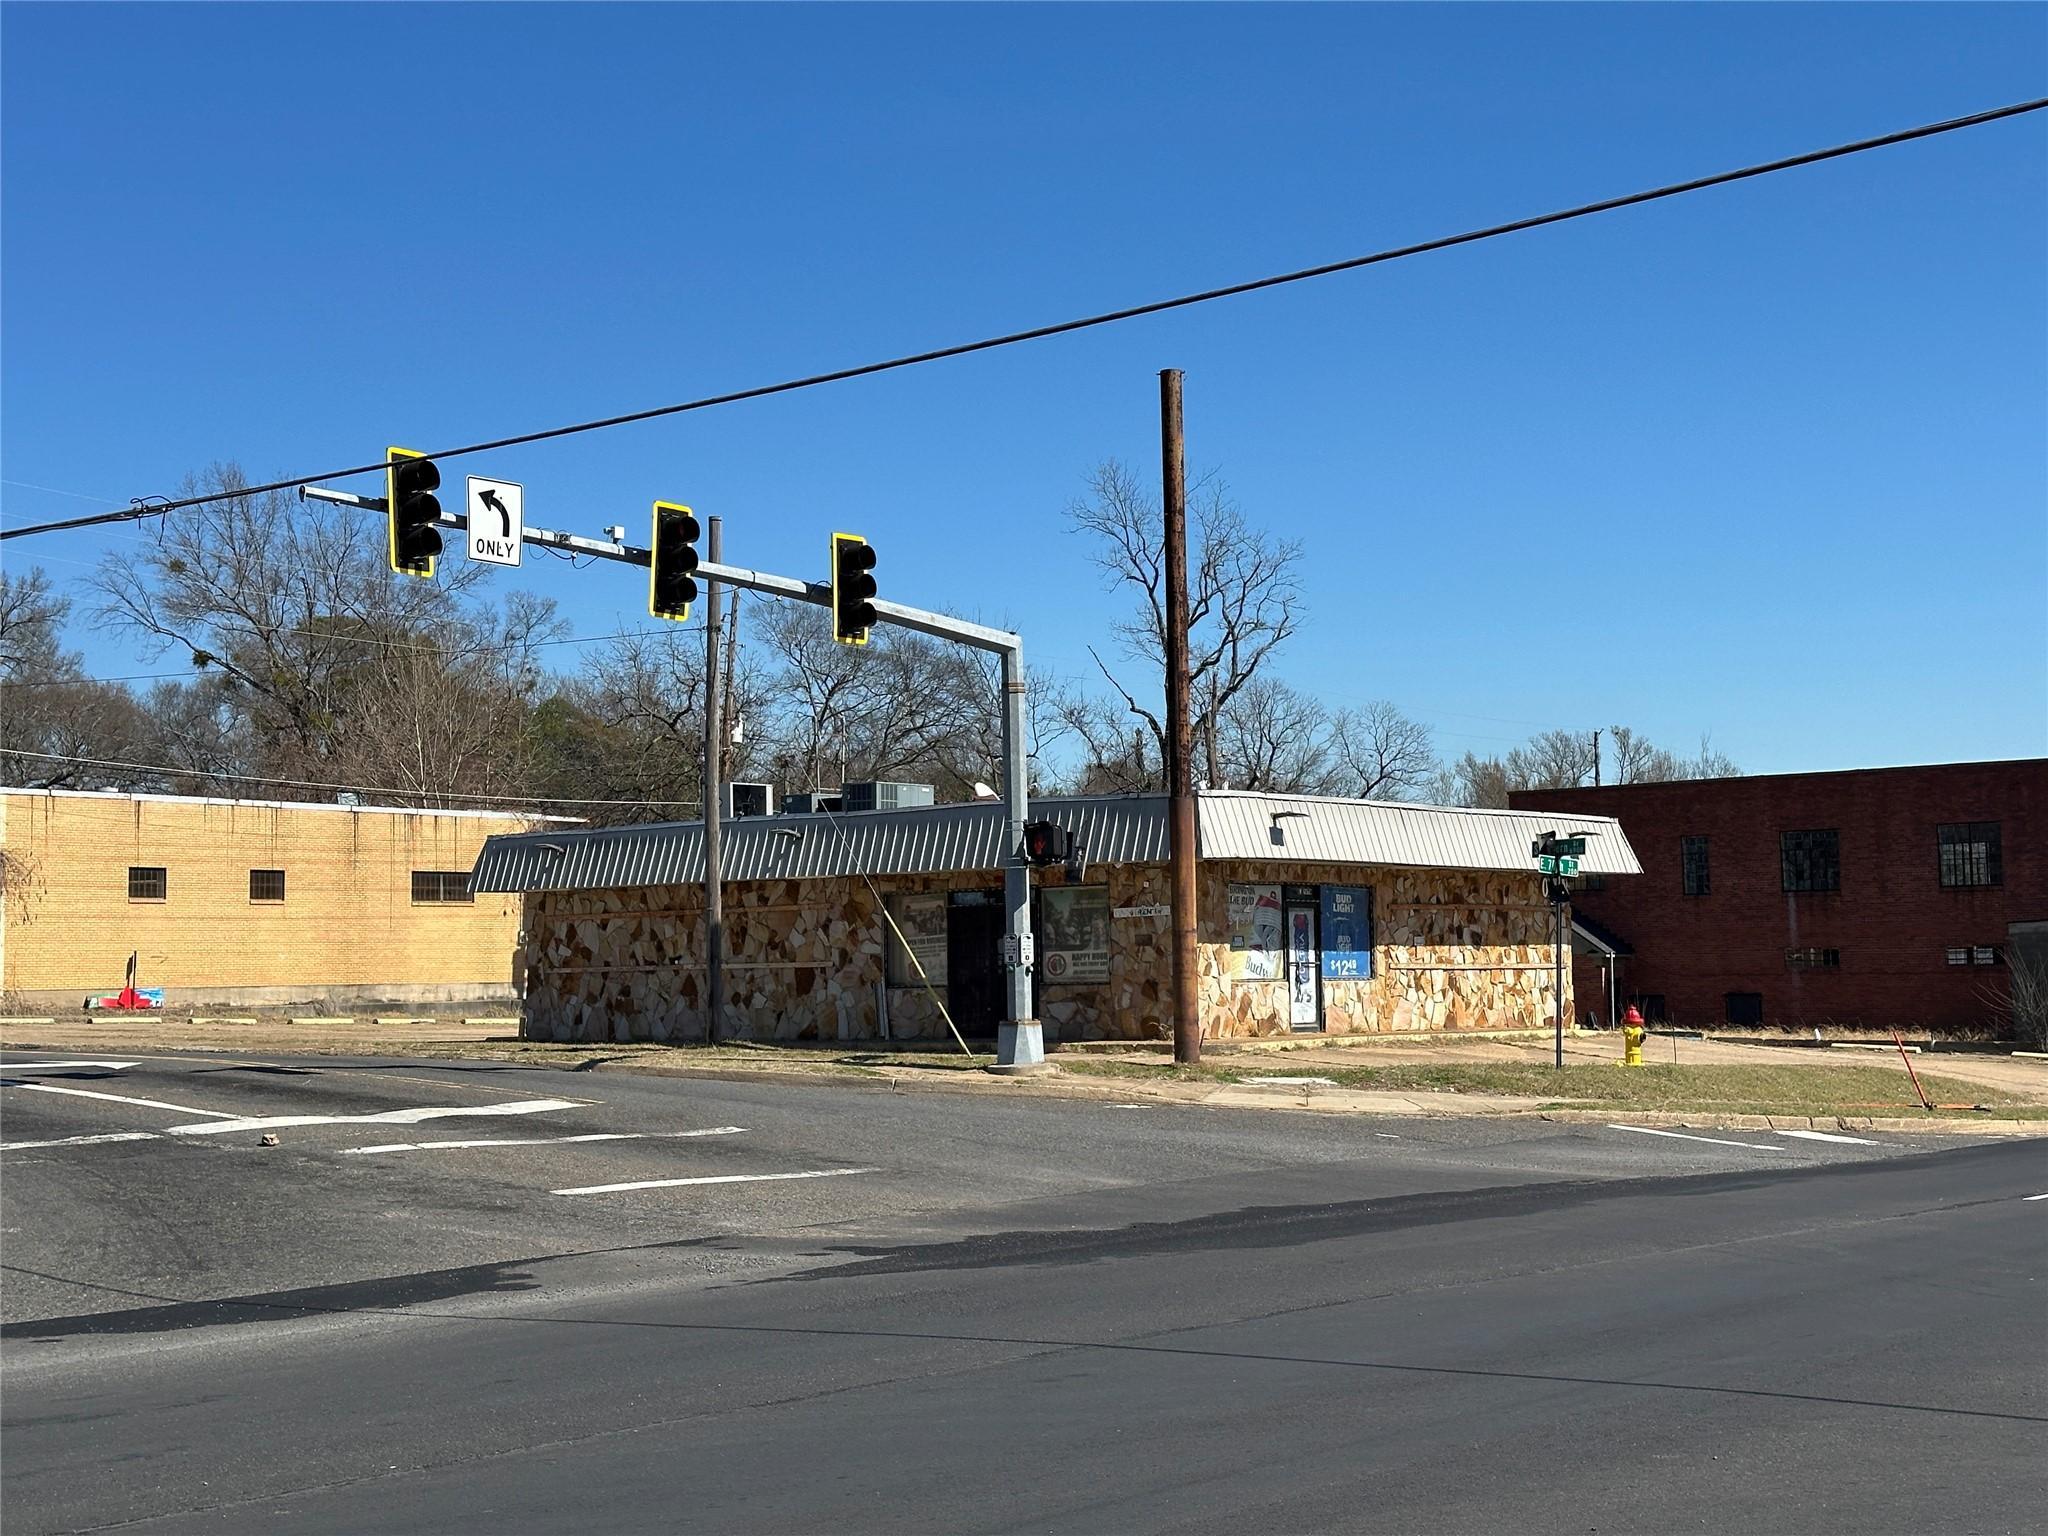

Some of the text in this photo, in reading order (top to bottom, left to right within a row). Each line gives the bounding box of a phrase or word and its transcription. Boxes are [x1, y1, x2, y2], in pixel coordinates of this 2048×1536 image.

[476, 538, 514, 558] ONLY
[1335, 893, 1352, 903] BUD
[1332, 903, 1355, 913] LIGHT
